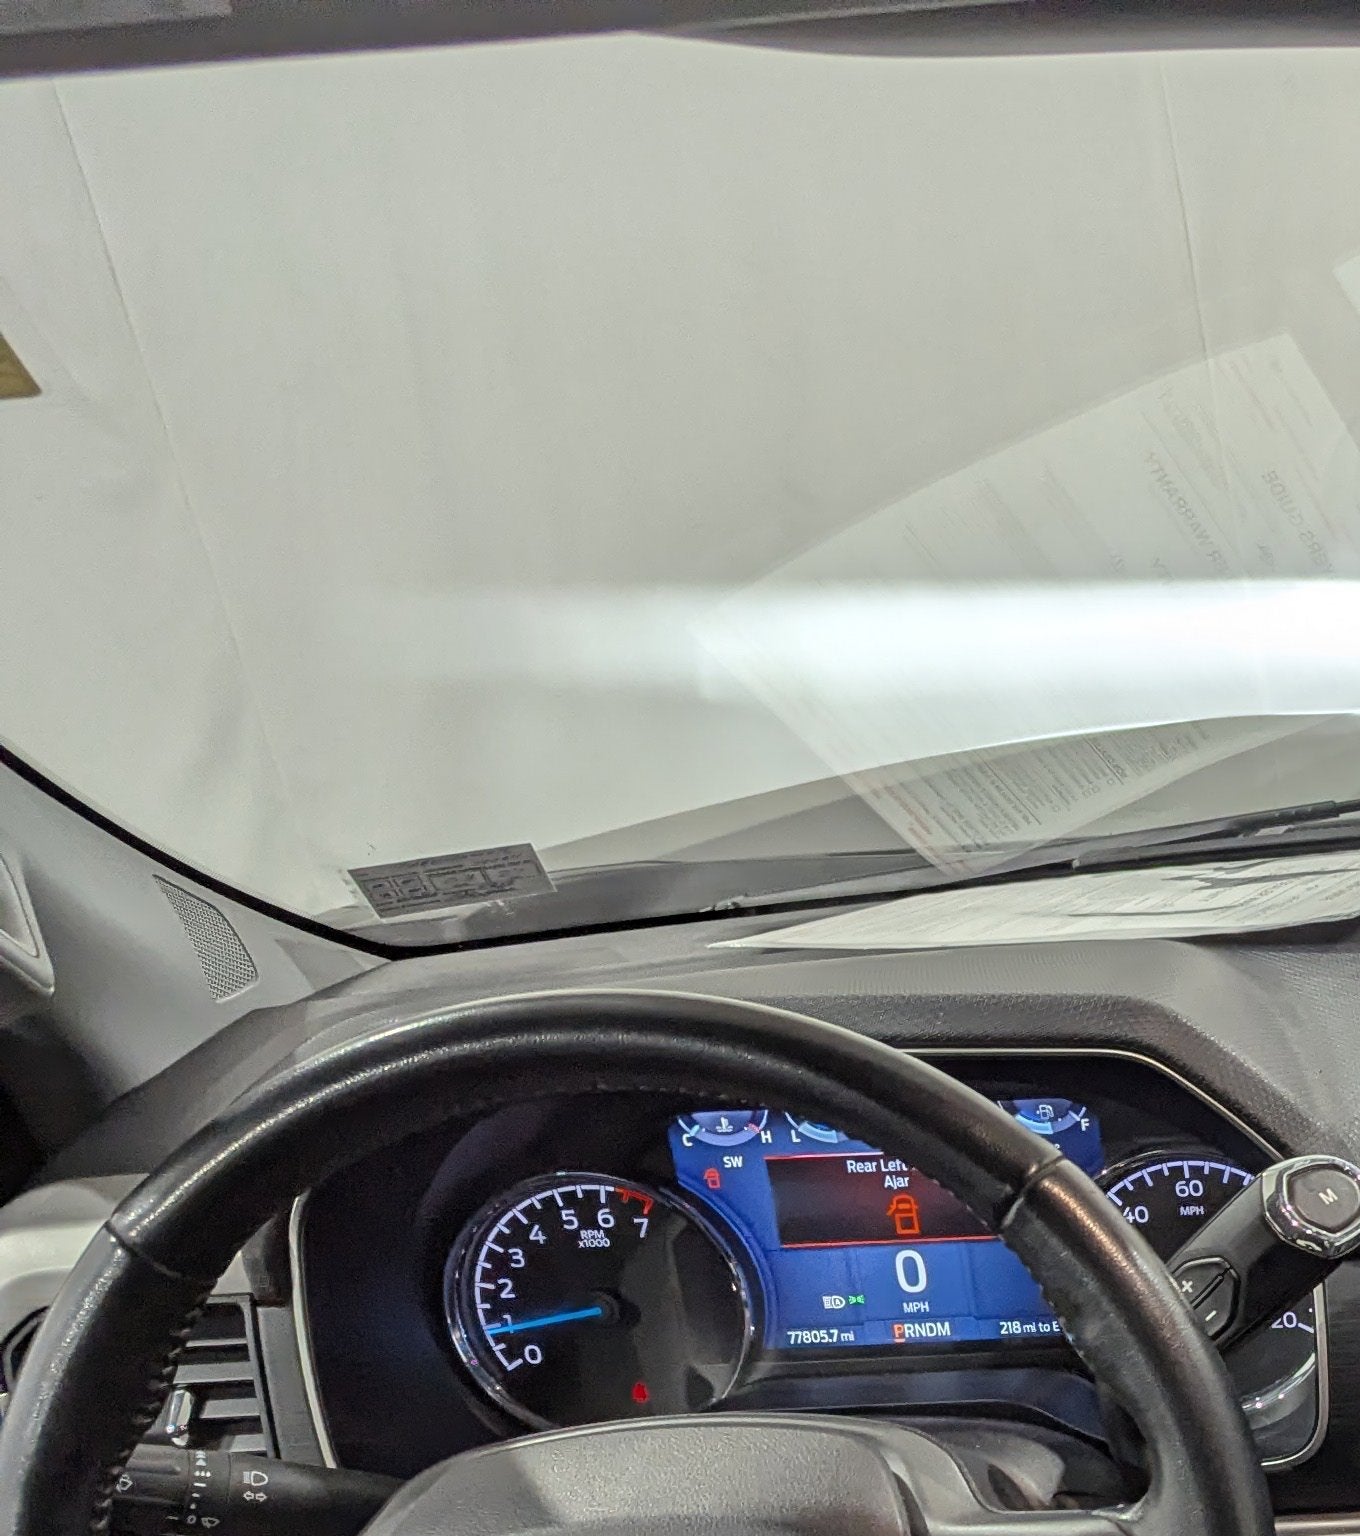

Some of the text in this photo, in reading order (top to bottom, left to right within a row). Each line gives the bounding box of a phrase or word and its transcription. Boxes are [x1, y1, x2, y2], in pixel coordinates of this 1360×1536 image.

[1080, 1117, 1091, 1132] F
[682, 1133, 694, 1148] C
[760, 1130, 773, 1144] H
[790, 1129, 802, 1143] L
[722, 1155, 744, 1169] SW
[846, 1158, 878, 1174] Rear
[883, 1174, 911, 1191] Ajar
[1174, 1179, 1205, 1198] 60
[1318, 1187, 1339, 1205] M
[560, 1208, 580, 1231] 5
[596, 1207, 616, 1229] 6
[1122, 1205, 1150, 1224] 40
[1179, 1205, 1206, 1217] MPH
[528, 1224, 548, 1246] 4
[579, 1228, 606, 1241] RPM
[632, 1217, 650, 1240] 7
[507, 1247, 526, 1269] 3
[894, 1248, 928, 1294] 0
[496, 1277, 517, 1300] 2
[902, 1301, 931, 1314] MPH
[893, 1320, 952, 1339] PRNDM
[999, 1320, 1022, 1335] 218
[1022, 1321, 1037, 1334] mi
[1038, 1320, 1051, 1333] to
[786, 1329, 856, 1346] 77805.7 mi
[523, 1343, 543, 1366] 0
